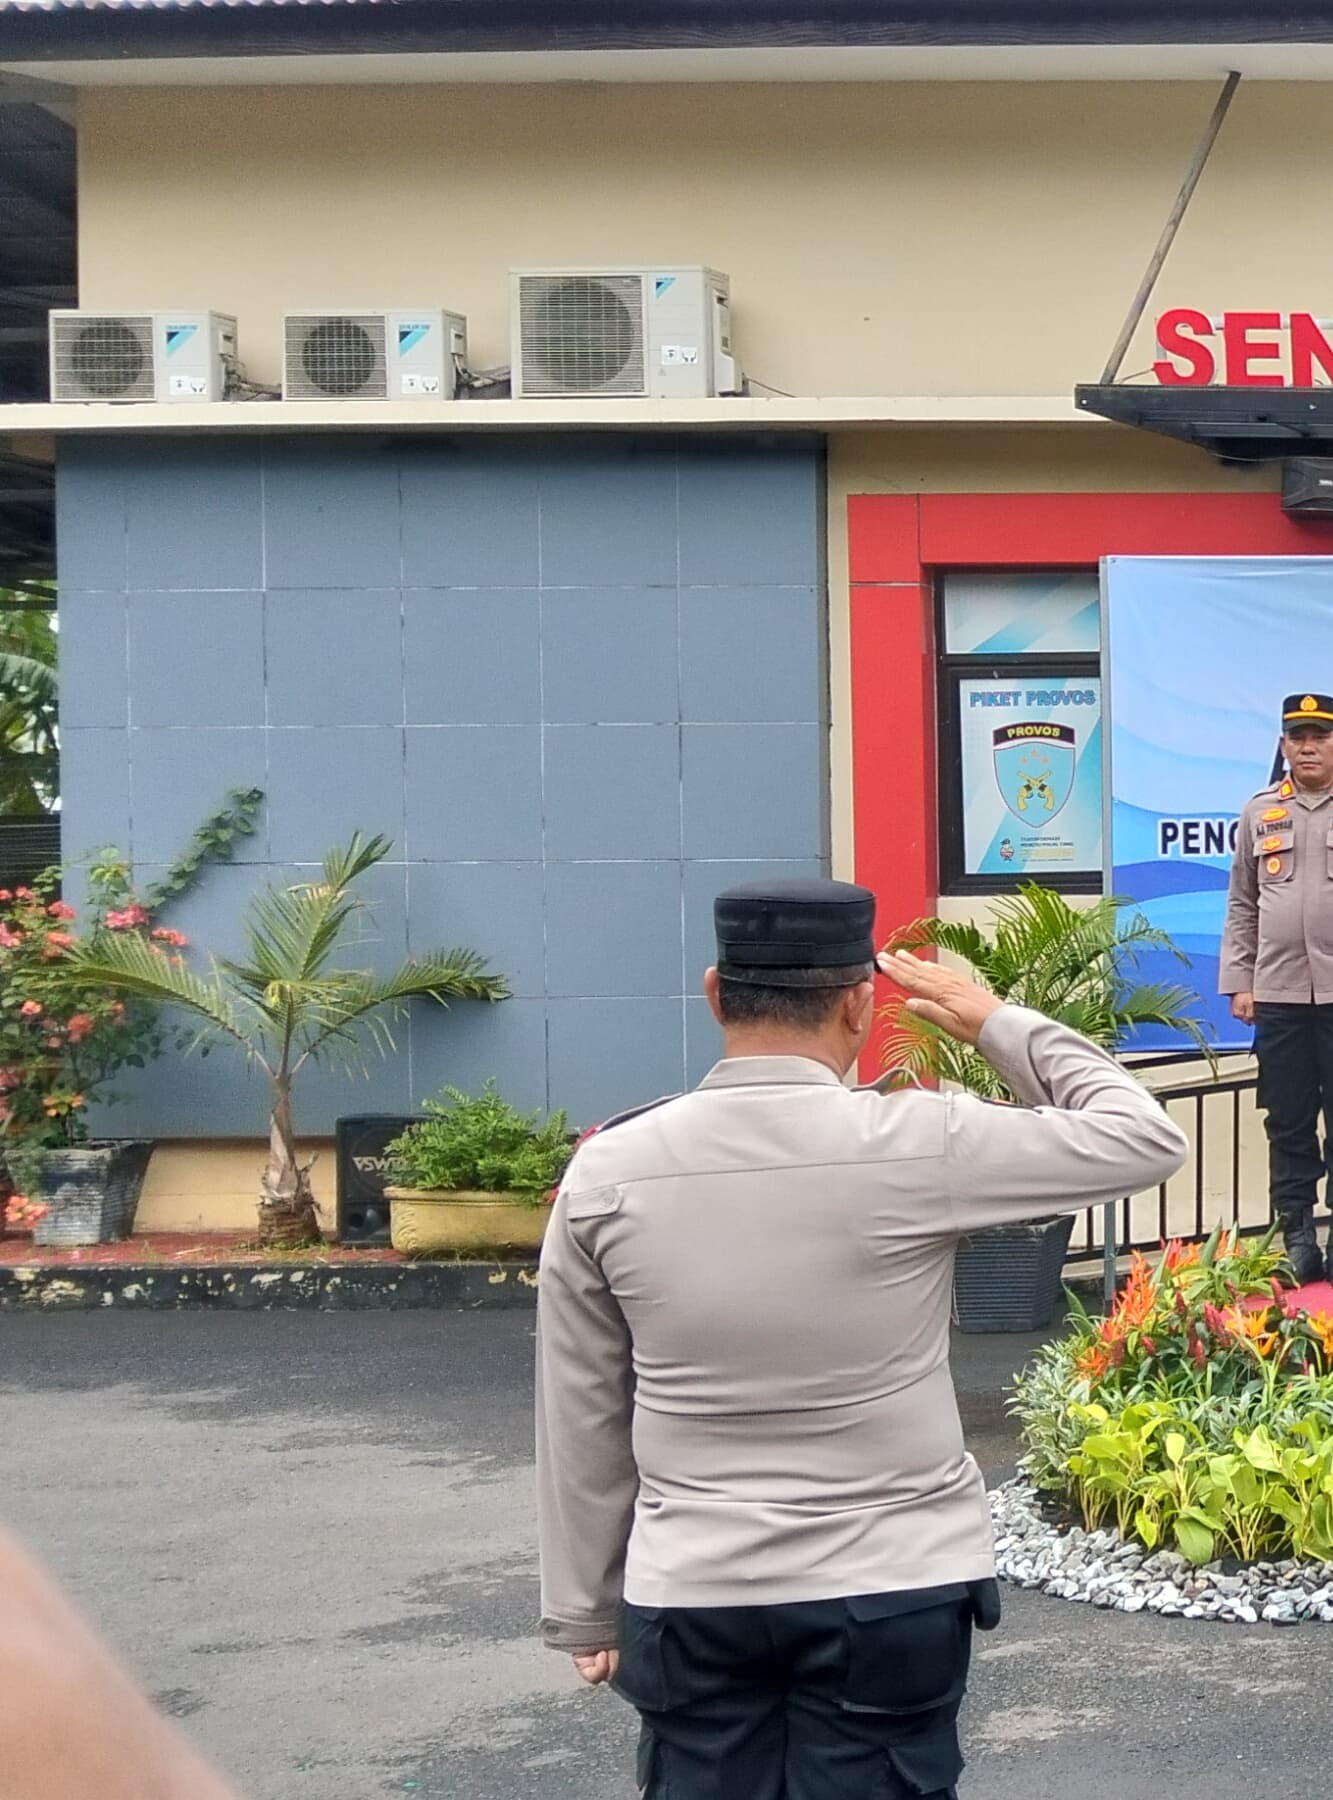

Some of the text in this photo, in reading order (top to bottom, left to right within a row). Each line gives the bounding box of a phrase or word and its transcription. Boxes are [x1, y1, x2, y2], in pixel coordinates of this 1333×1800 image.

[969, 689, 1096, 707] PIKET PROVOS
[1006, 725, 1061, 738] PROVOS
